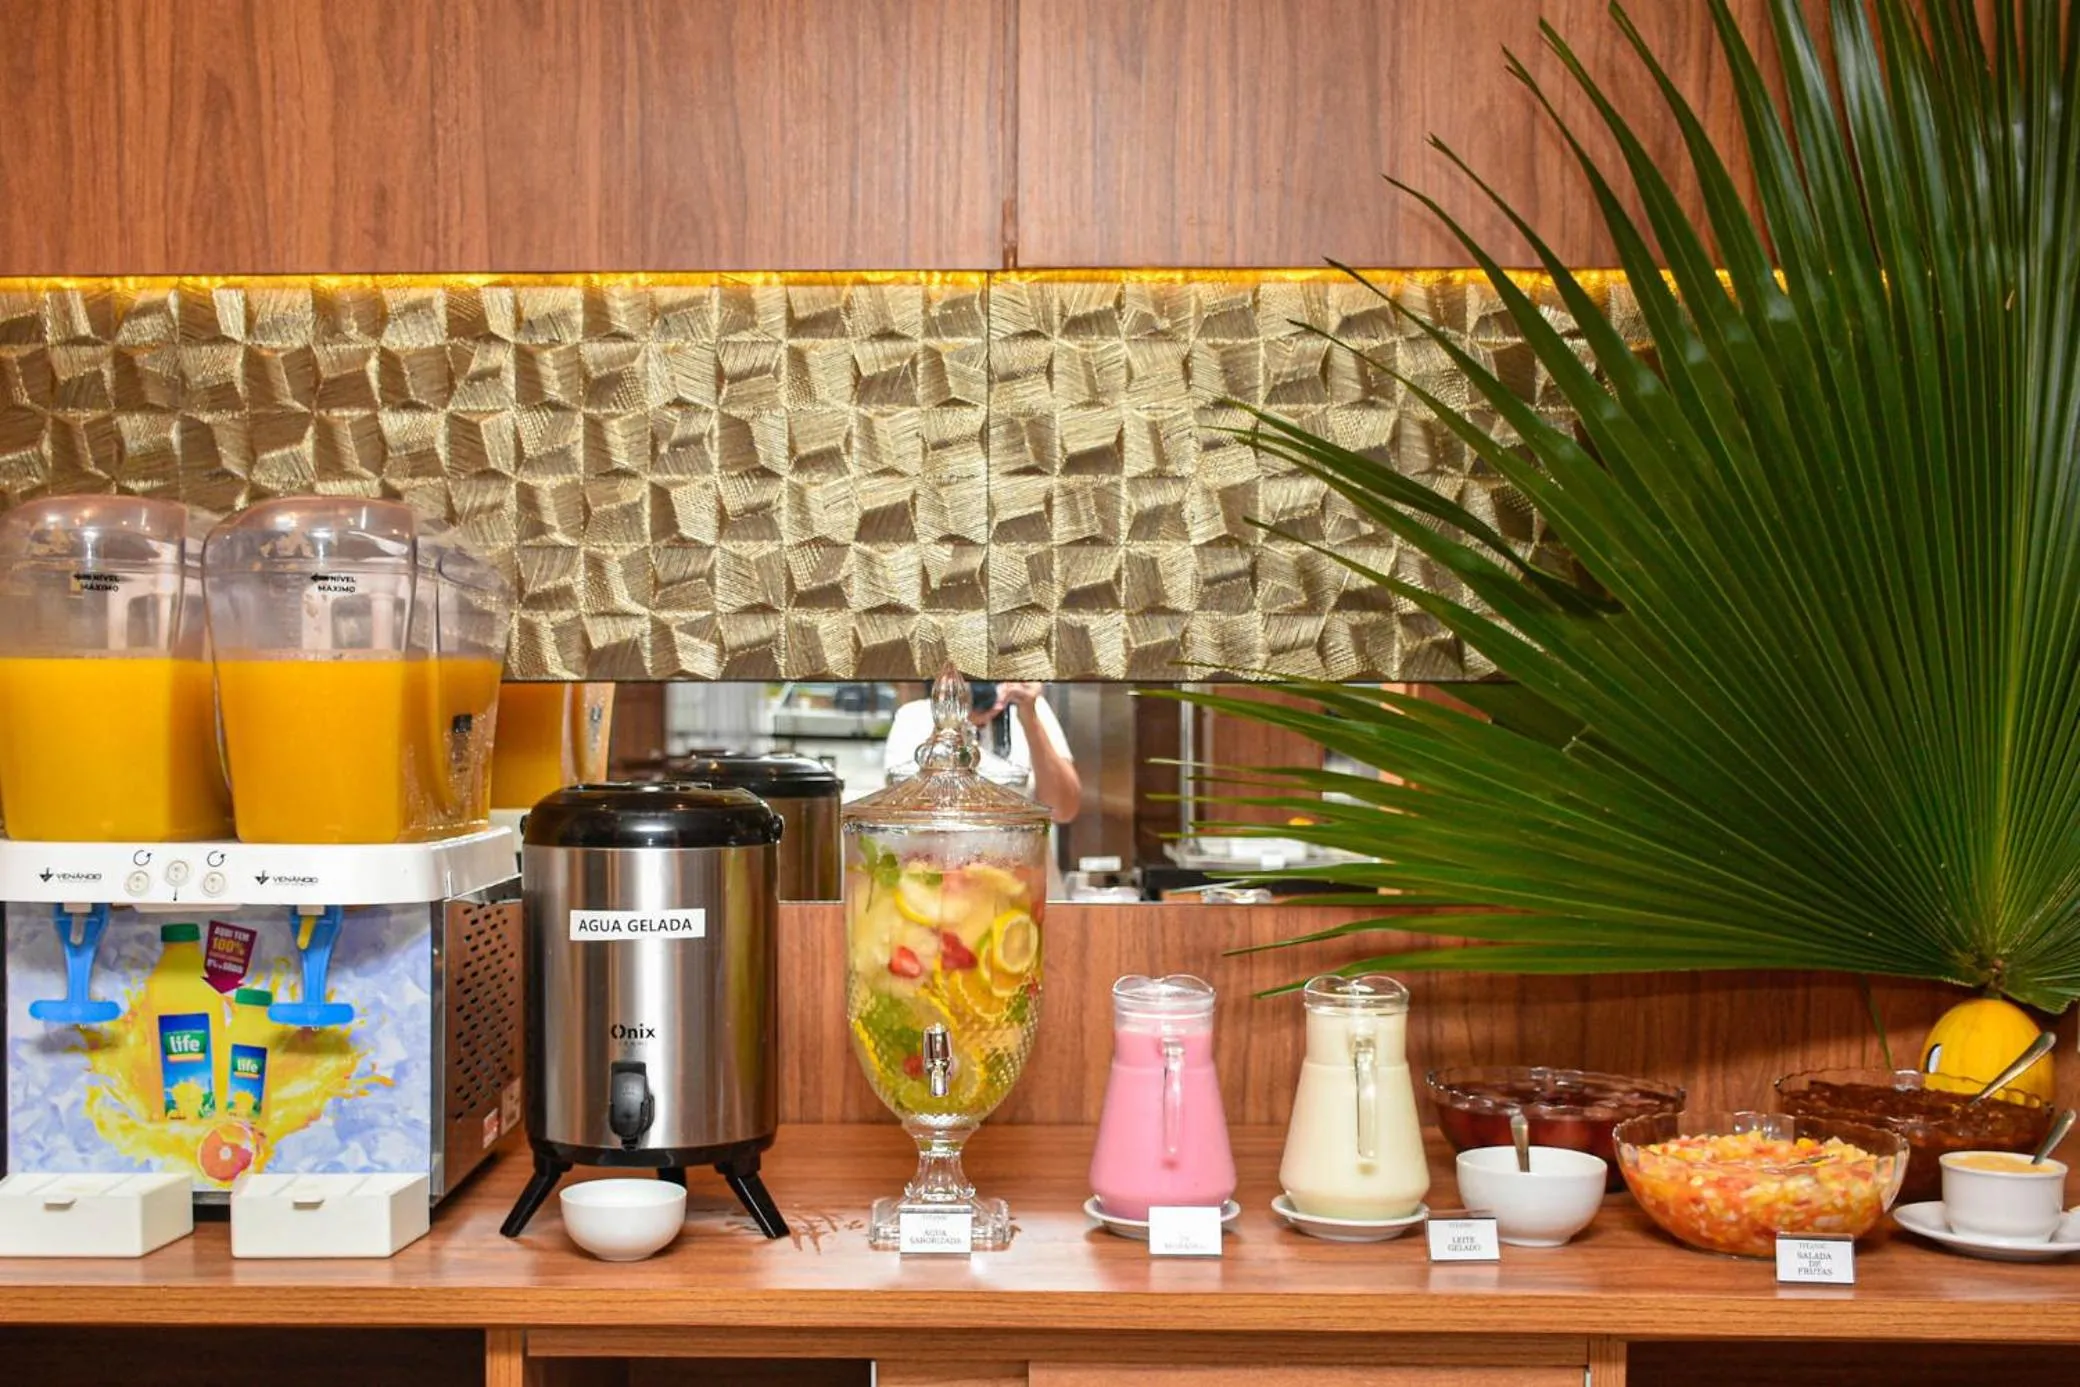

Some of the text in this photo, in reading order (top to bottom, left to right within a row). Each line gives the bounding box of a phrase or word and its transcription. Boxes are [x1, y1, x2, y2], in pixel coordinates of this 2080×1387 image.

[578, 917, 693, 932] AGUA GELADA
[212, 937, 245, 955] 100%
[611, 1023, 656, 1039] Onix
[169, 1034, 201, 1053] life
[237, 1058, 259, 1073] life
[1796, 1251, 1833, 1260] SALADA
[1797, 1267, 1833, 1276] FRUTAS
